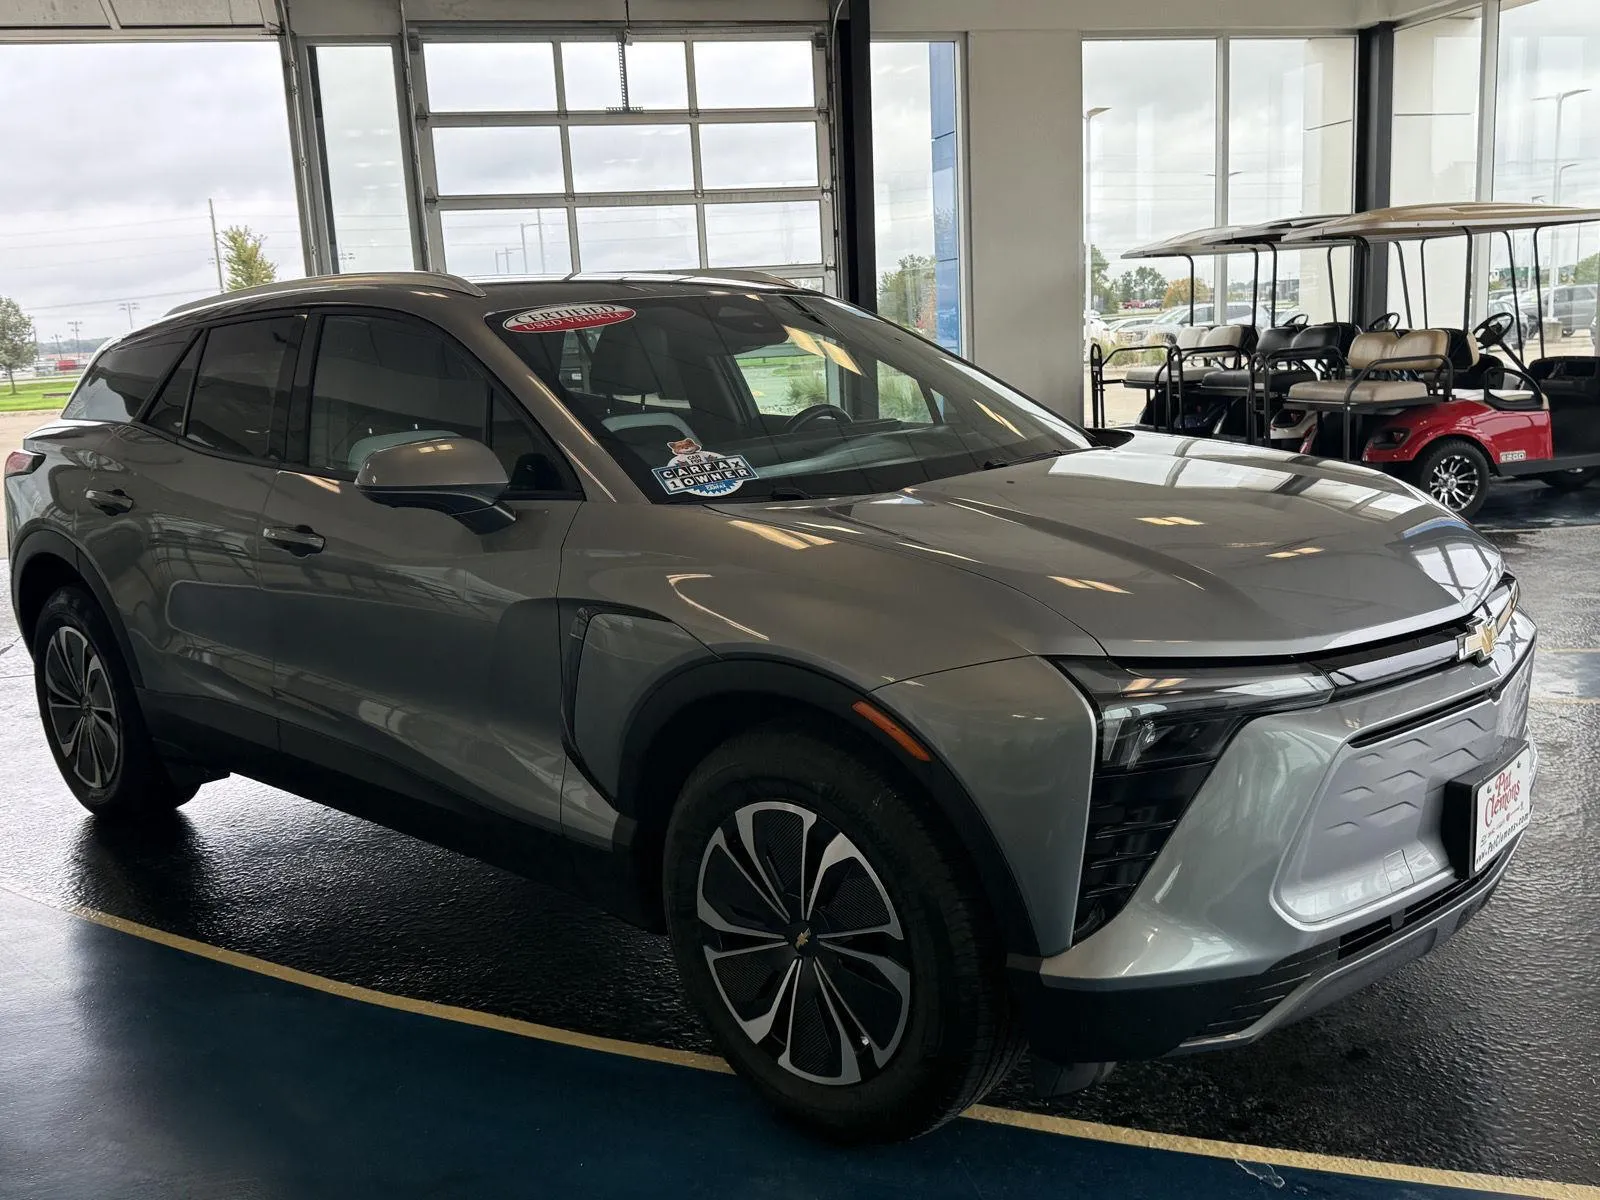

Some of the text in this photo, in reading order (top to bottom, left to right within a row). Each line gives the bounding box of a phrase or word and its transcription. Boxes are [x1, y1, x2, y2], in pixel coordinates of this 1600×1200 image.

[514, 304, 617, 324] CERTIFIED
[523, 311, 625, 330] USED VEHICLE
[662, 460, 742, 479] CARFAX
[670, 468, 749, 489] 1 OWNER
[1495, 770, 1512, 796] Pat
[1484, 780, 1520, 828] Clemons
